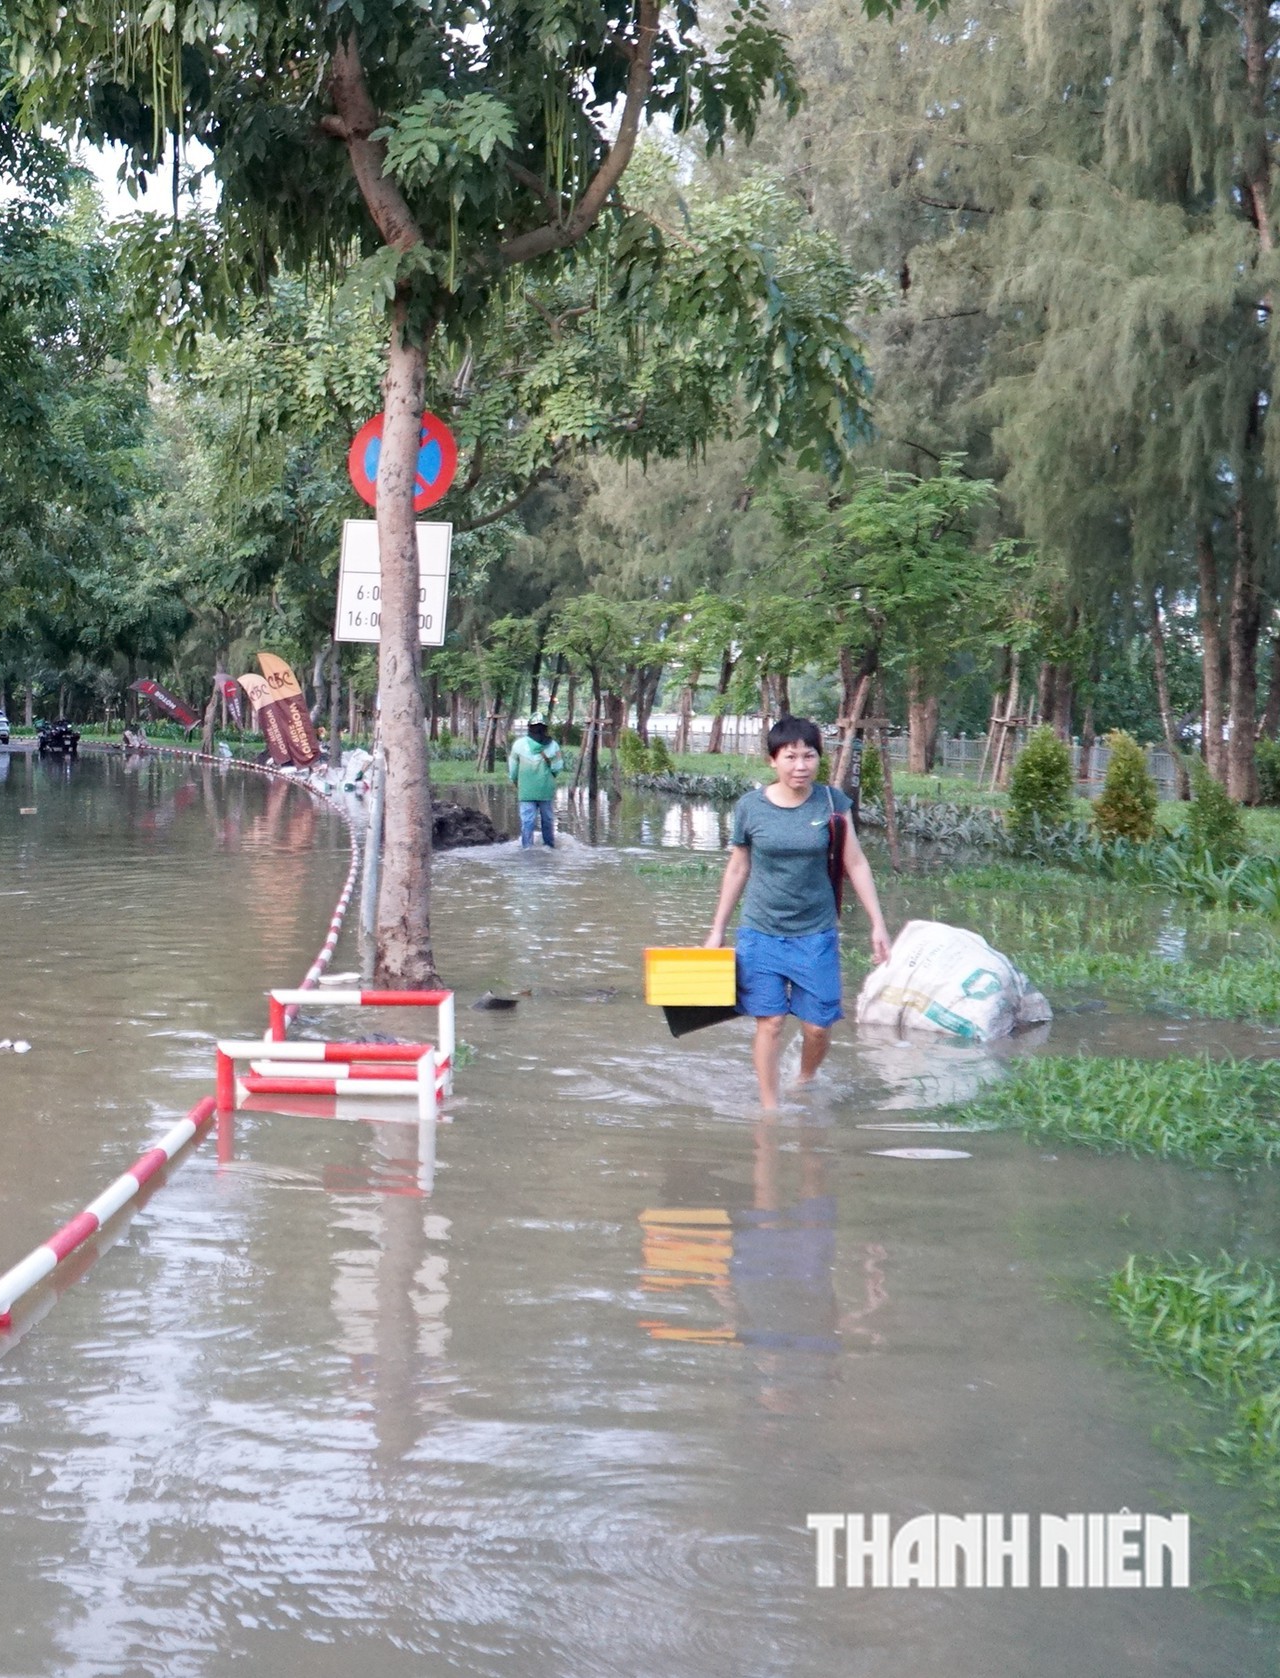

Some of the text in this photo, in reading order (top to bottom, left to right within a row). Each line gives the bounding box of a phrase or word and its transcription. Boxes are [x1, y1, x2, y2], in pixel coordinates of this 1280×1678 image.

[356, 585, 381, 601] 6:0
[348, 611, 381, 627] 16:0
[153, 690, 177, 710] MOTOR
[266, 709, 289, 755] WORKSHOP
[289, 702, 315, 759] WORKSHOP
